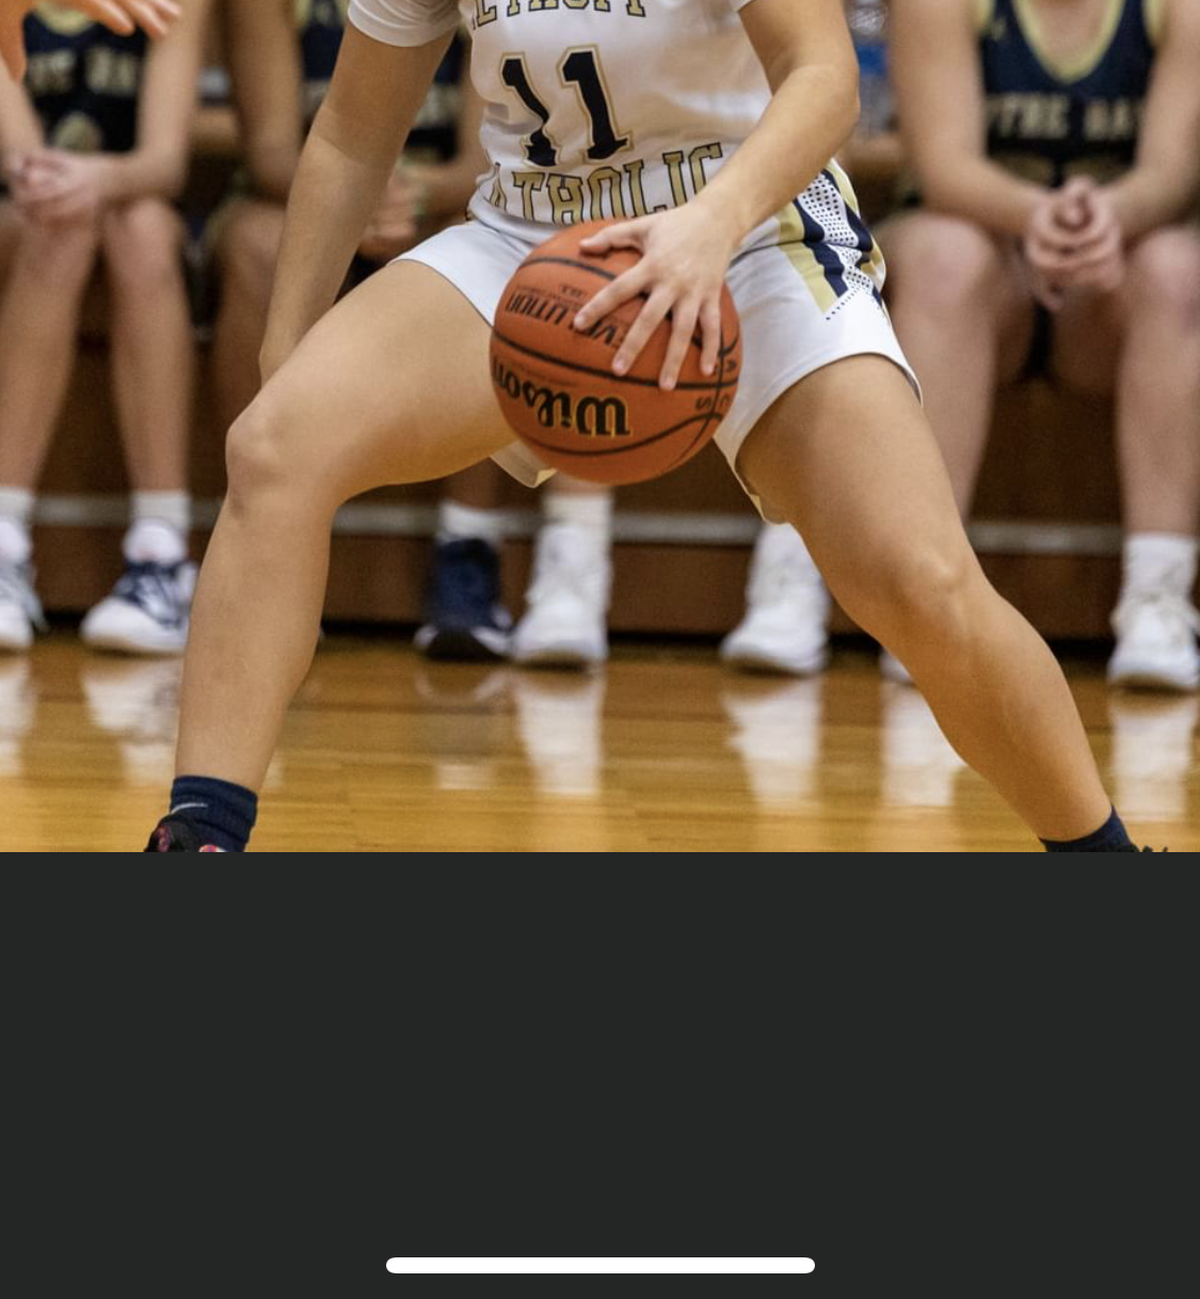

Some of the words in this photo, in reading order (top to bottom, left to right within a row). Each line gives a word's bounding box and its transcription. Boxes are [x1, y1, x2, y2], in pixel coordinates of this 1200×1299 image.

[500, 43, 634, 168] 11
[480, 141, 723, 227] ATHOLIC
[493, 355, 632, 437] Wilson
